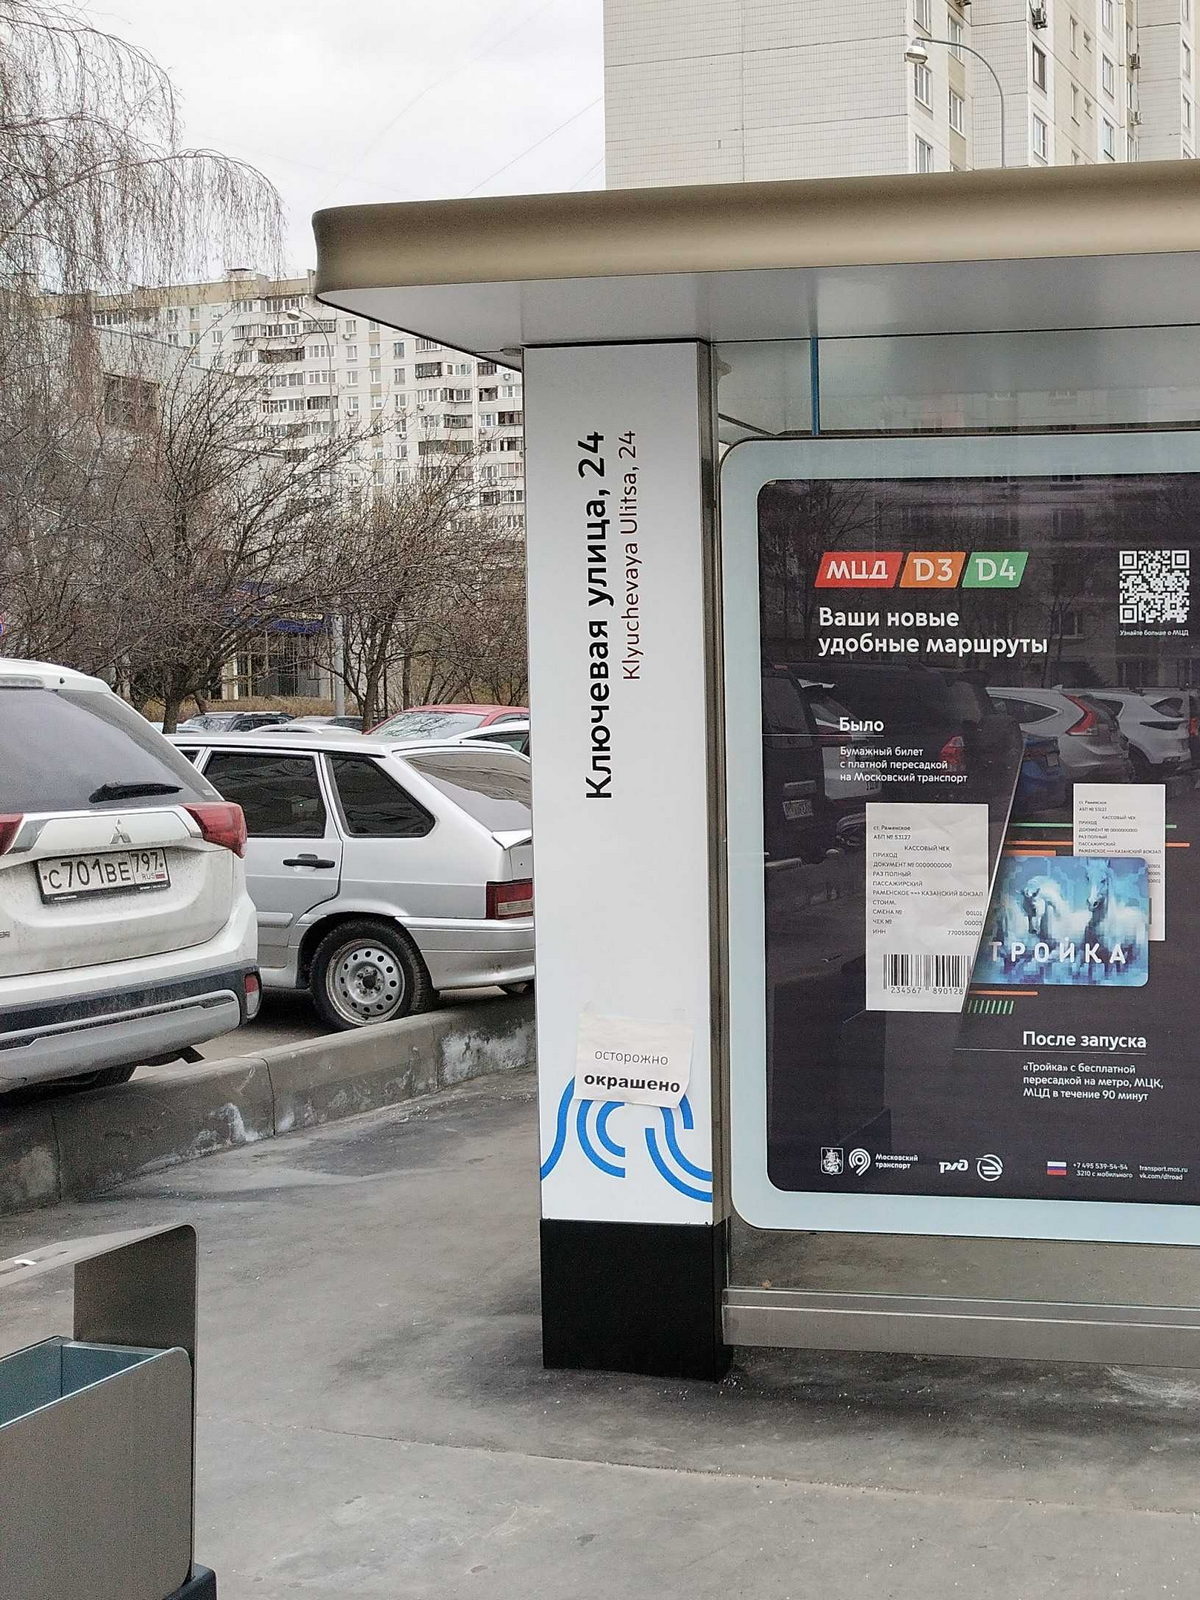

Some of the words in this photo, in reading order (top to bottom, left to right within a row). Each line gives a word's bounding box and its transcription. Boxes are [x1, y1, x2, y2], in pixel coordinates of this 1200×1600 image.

[618, 430, 637, 460] 24
[577, 431, 606, 479] 24
[619, 466, 640, 534] Ulitsa,
[586, 488, 614, 607] улица,
[826, 559, 889, 580] МЦД
[913, 558, 953, 581] D3
[975, 558, 1016, 581] D4
[621, 542, 644, 681] Klyuchevaya
[819, 606, 880, 627] Ваши
[887, 610, 960, 628] новые
[818, 632, 920, 657] удобные
[926, 636, 1048, 658] маршруты
[585, 620, 612, 799] Ключевая
[839, 716, 885, 732] Было
[840, 746, 892, 757] Бумажный
[894, 746, 924, 757] билет
[840, 761, 845, 769] с
[848, 759, 888, 769] платной
[890, 760, 948, 770] пересадкой
[840, 774, 852, 782] на
[853, 772, 915, 783] Московский
[917, 774, 968, 785] транспорт
[904, 844, 938, 852] КАССОВЫЙ
[131, 851, 159, 873] 797
[141, 872, 155, 881] RUS
[890, 986, 922, 995] 234567
[932, 987, 964, 996] 890128
[1023, 1030, 1077, 1047] После
[1080, 1034, 1147, 1051] запуска
[594, 1050, 669, 1066] осторожно
[1023, 1062, 1068, 1073] «Тройка»
[1078, 1063, 1136, 1074] бесплатной
[583, 1073, 681, 1094] окрашено
[1023, 1075, 1082, 1087] пересадкой
[1084, 1078, 1096, 1086] на
[1098, 1080, 1132, 1089] метро,
[1134, 1078, 1164, 1089] МЦК,
[1023, 1087, 1051, 1099] МЦД
[1052, 1090, 1058, 1098] в
[1060, 1090, 1100, 1100] течение
[1102, 1089, 1116, 1100] 90
[1117, 1091, 1149, 1103] минут
[875, 1153, 919, 1162] Московский
[875, 1161, 911, 1170] транспорт
[1081, 1162, 1095, 1170] 495
[1139, 1165, 1189, 1174] transport.mos.ru
